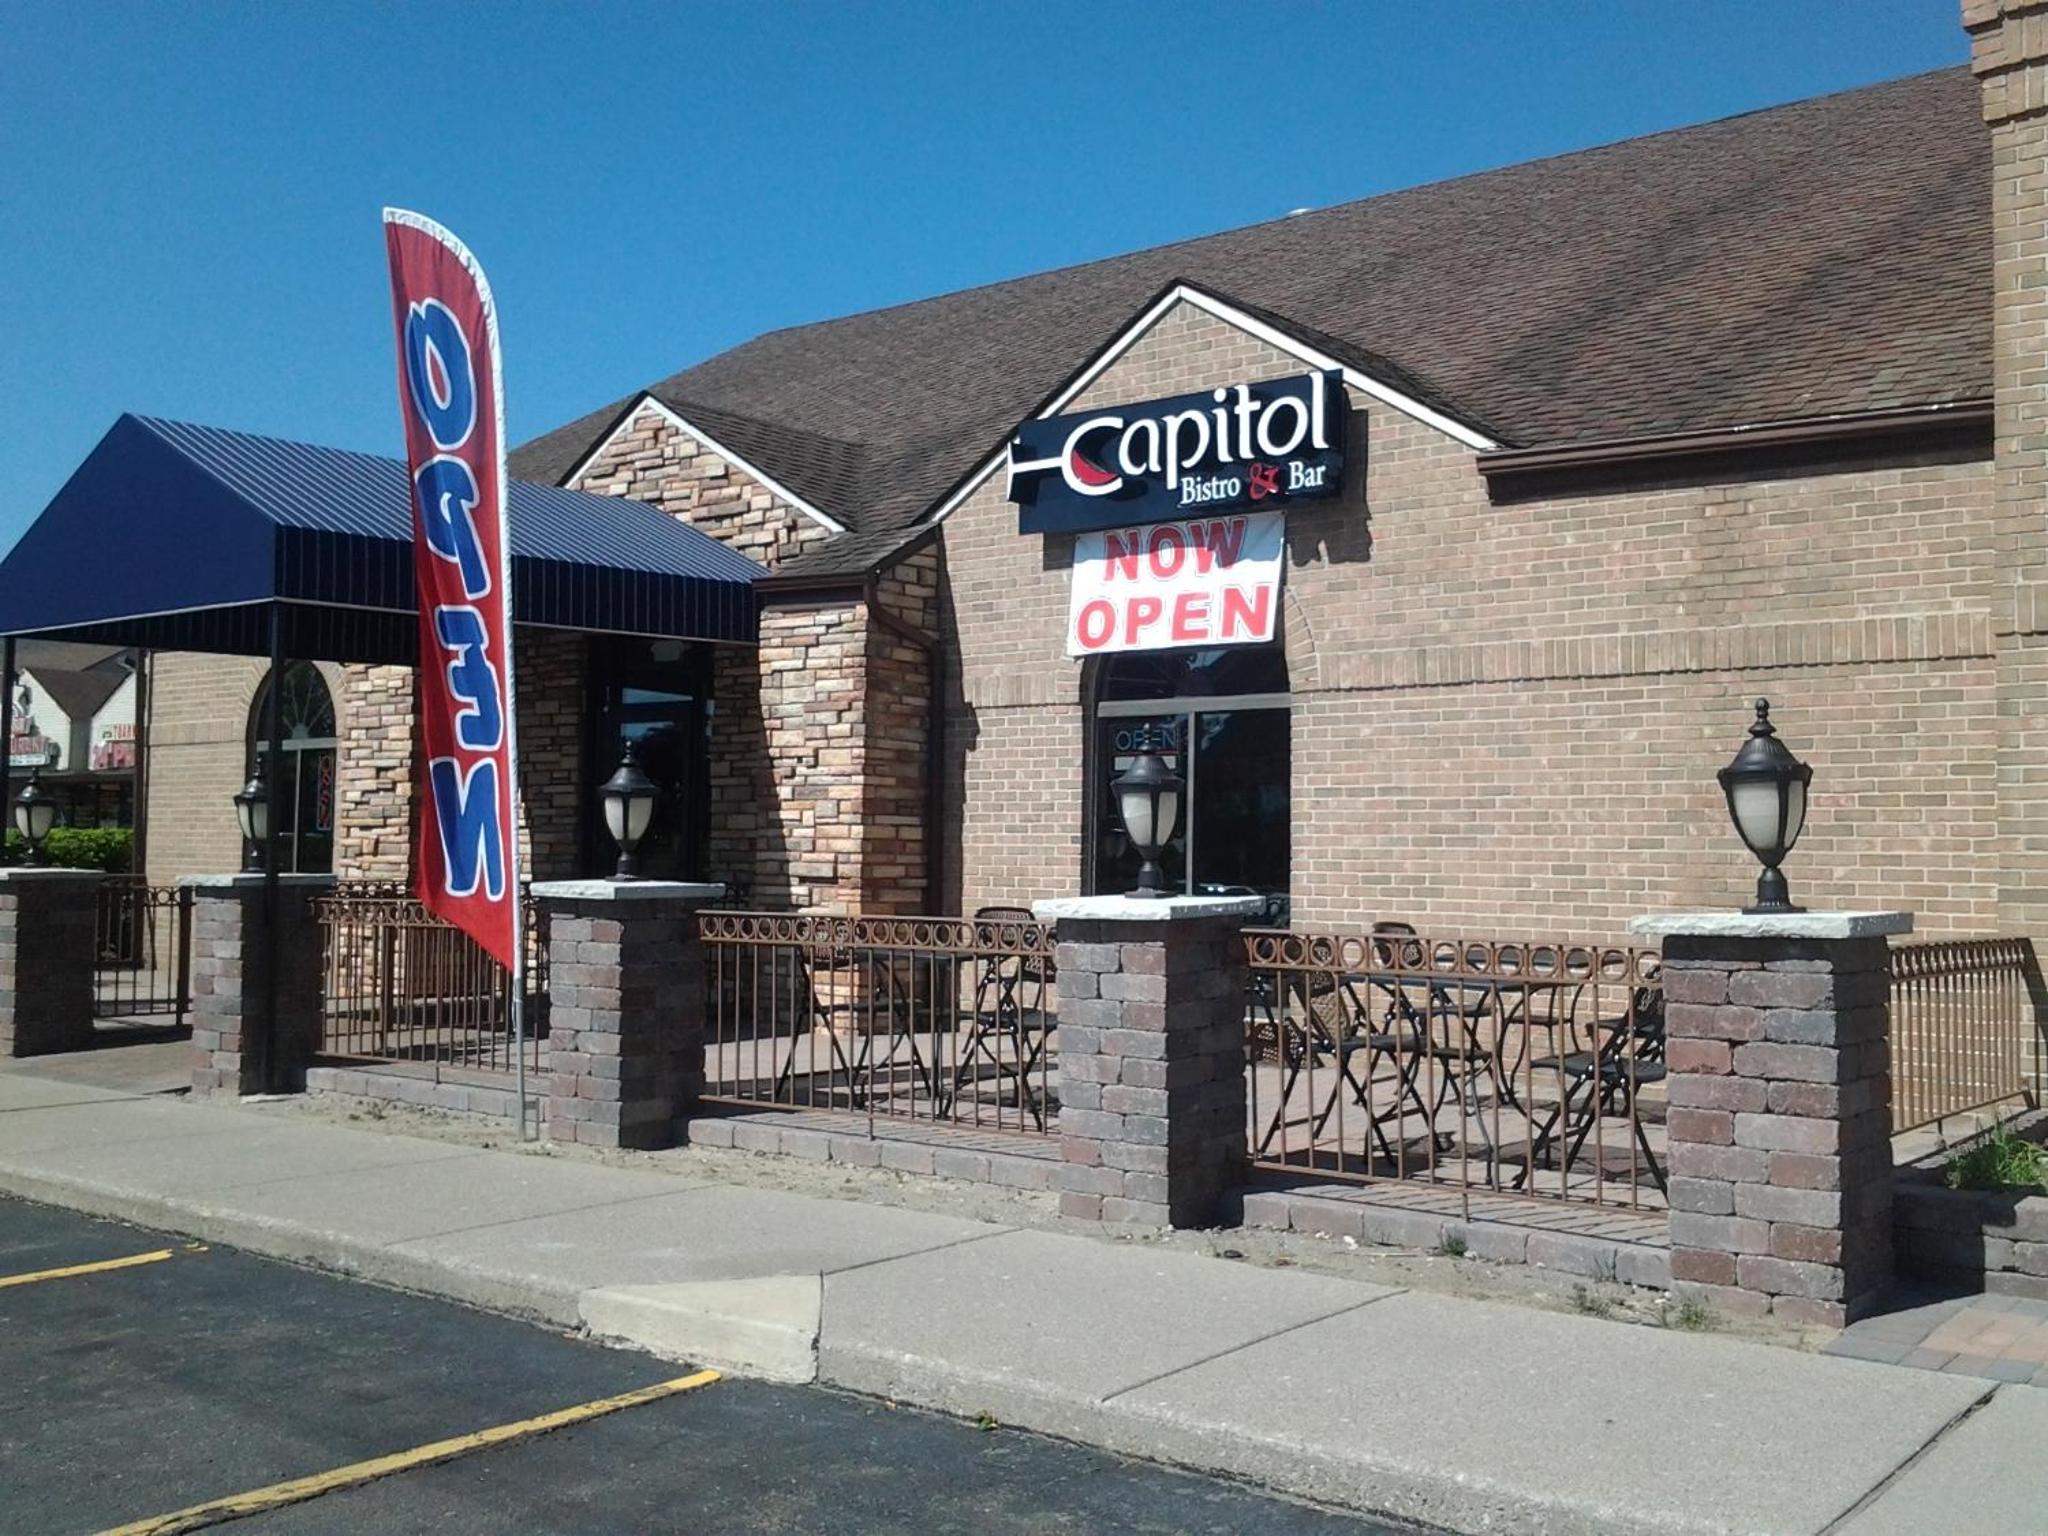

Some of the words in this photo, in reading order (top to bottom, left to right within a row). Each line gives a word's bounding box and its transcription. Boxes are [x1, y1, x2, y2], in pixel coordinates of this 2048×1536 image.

[1062, 372, 1329, 495] Capitol
[1179, 475, 1241, 504] Bistro
[1249, 463, 1280, 500] &
[1288, 460, 1326, 490] Bar
[1104, 517, 1248, 583] NOW
[1075, 584, 1273, 650] OPEN
